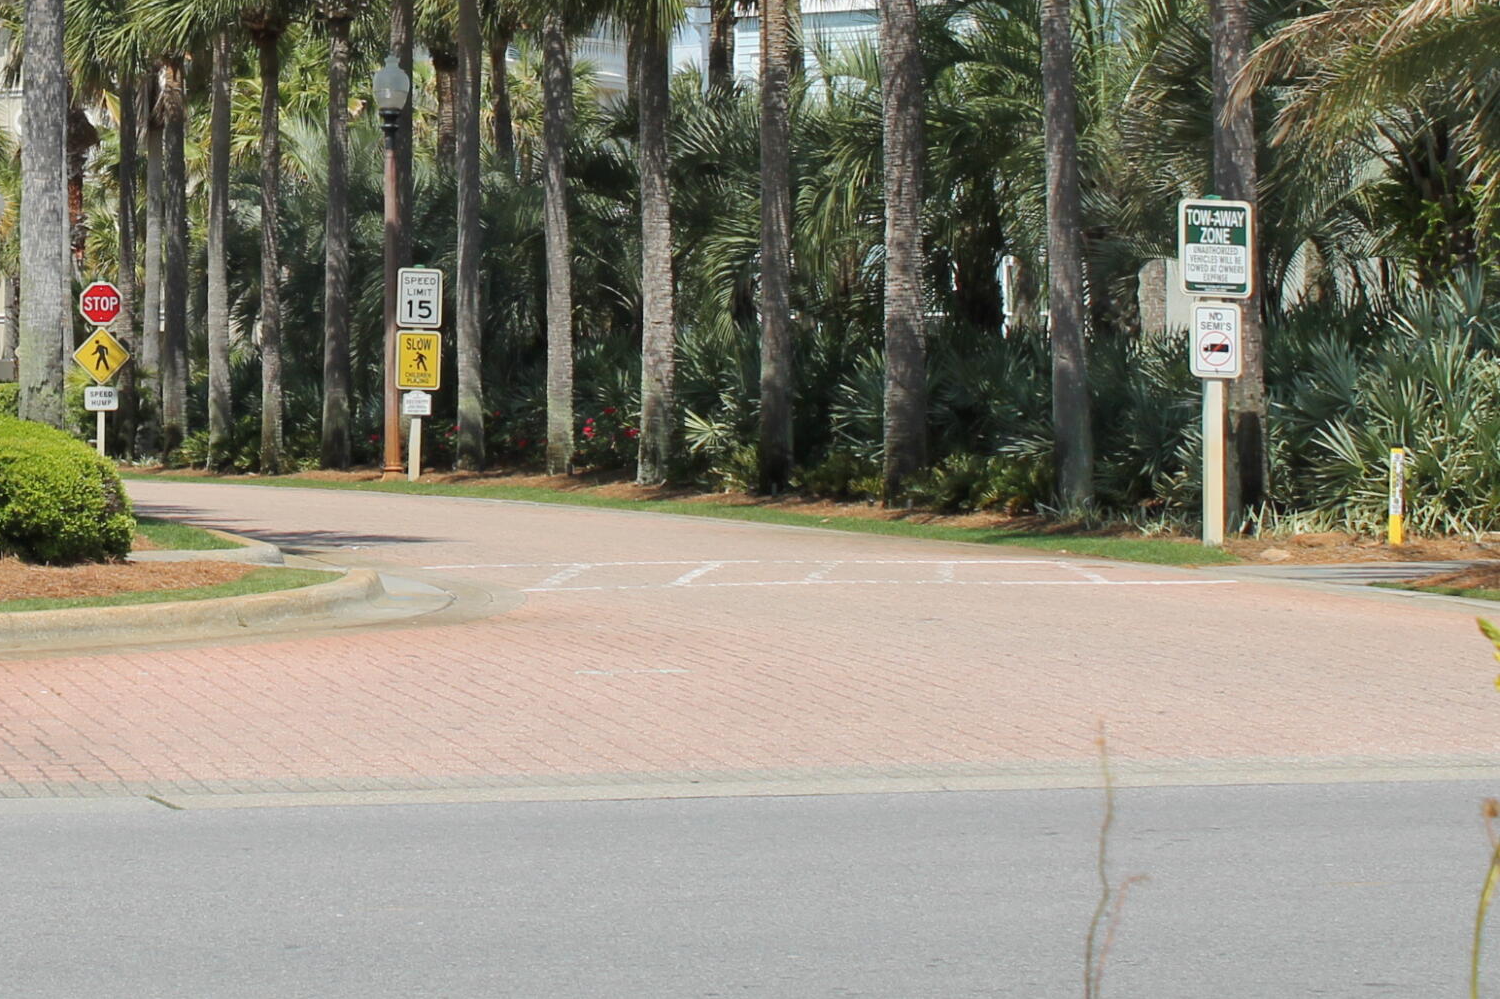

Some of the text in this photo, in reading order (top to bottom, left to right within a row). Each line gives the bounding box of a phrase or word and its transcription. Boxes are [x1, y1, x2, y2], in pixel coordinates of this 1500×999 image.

[1186, 209, 1245, 227] TOW-AWAY
[1200, 227, 1230, 244] ZONE
[1193, 246, 1238, 255] UNAUTHORIZED
[1189, 254, 1218, 264] VEHICLES
[1219, 256, 1233, 264] WILL
[1187, 264, 1209, 272] TOWED
[1219, 265, 1244, 274] OWNERS
[404, 276, 436, 286] SPEED
[84, 296, 118, 311] STOP
[407, 299, 432, 319] 15
[1209, 312, 1223, 321] NO
[1200, 322, 1232, 331] SEMI'S
[406, 337, 432, 351] SLOW
